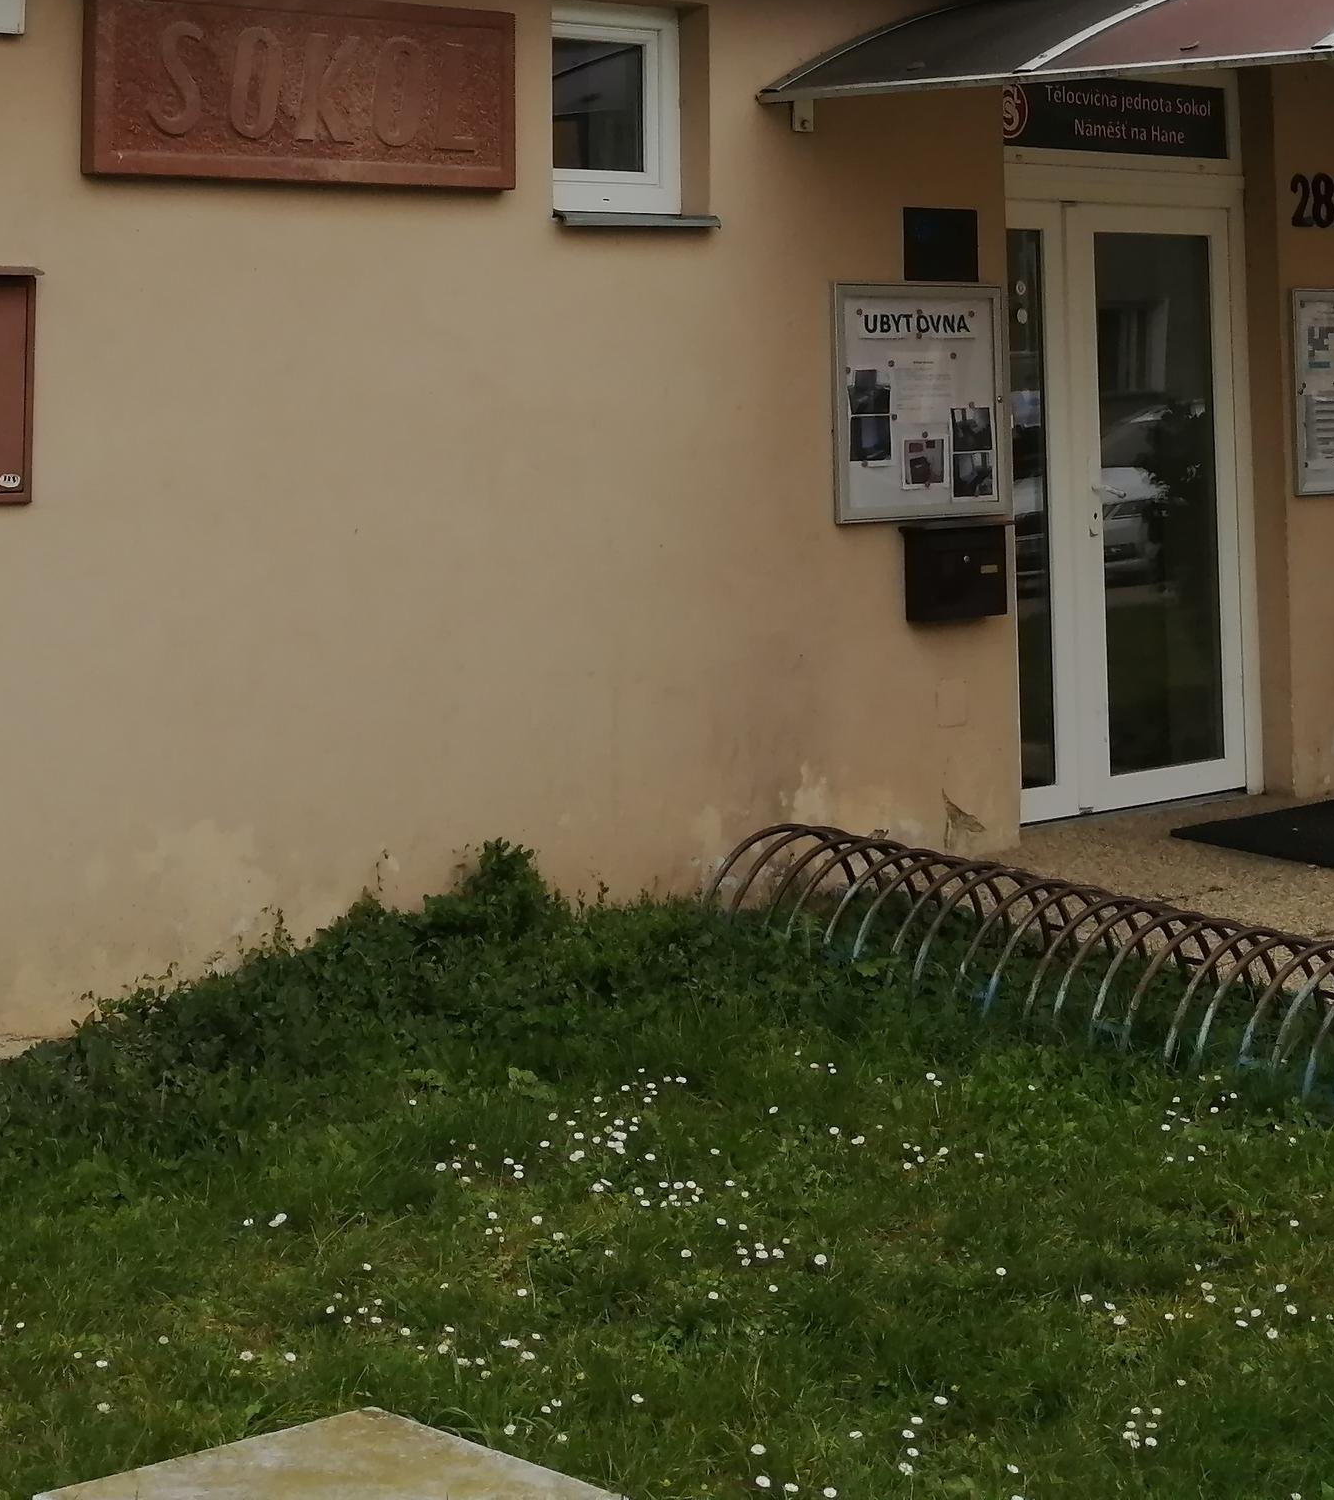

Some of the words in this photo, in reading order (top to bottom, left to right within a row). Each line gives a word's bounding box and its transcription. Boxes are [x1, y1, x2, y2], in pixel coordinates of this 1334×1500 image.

[144, 20, 477, 153] SOKOL
[1120, 91, 1172, 113] jednota
[1176, 98, 1212, 117] Sokol
[1131, 127, 1147, 142] na
[863, 313, 971, 334] UBYTOVNA
